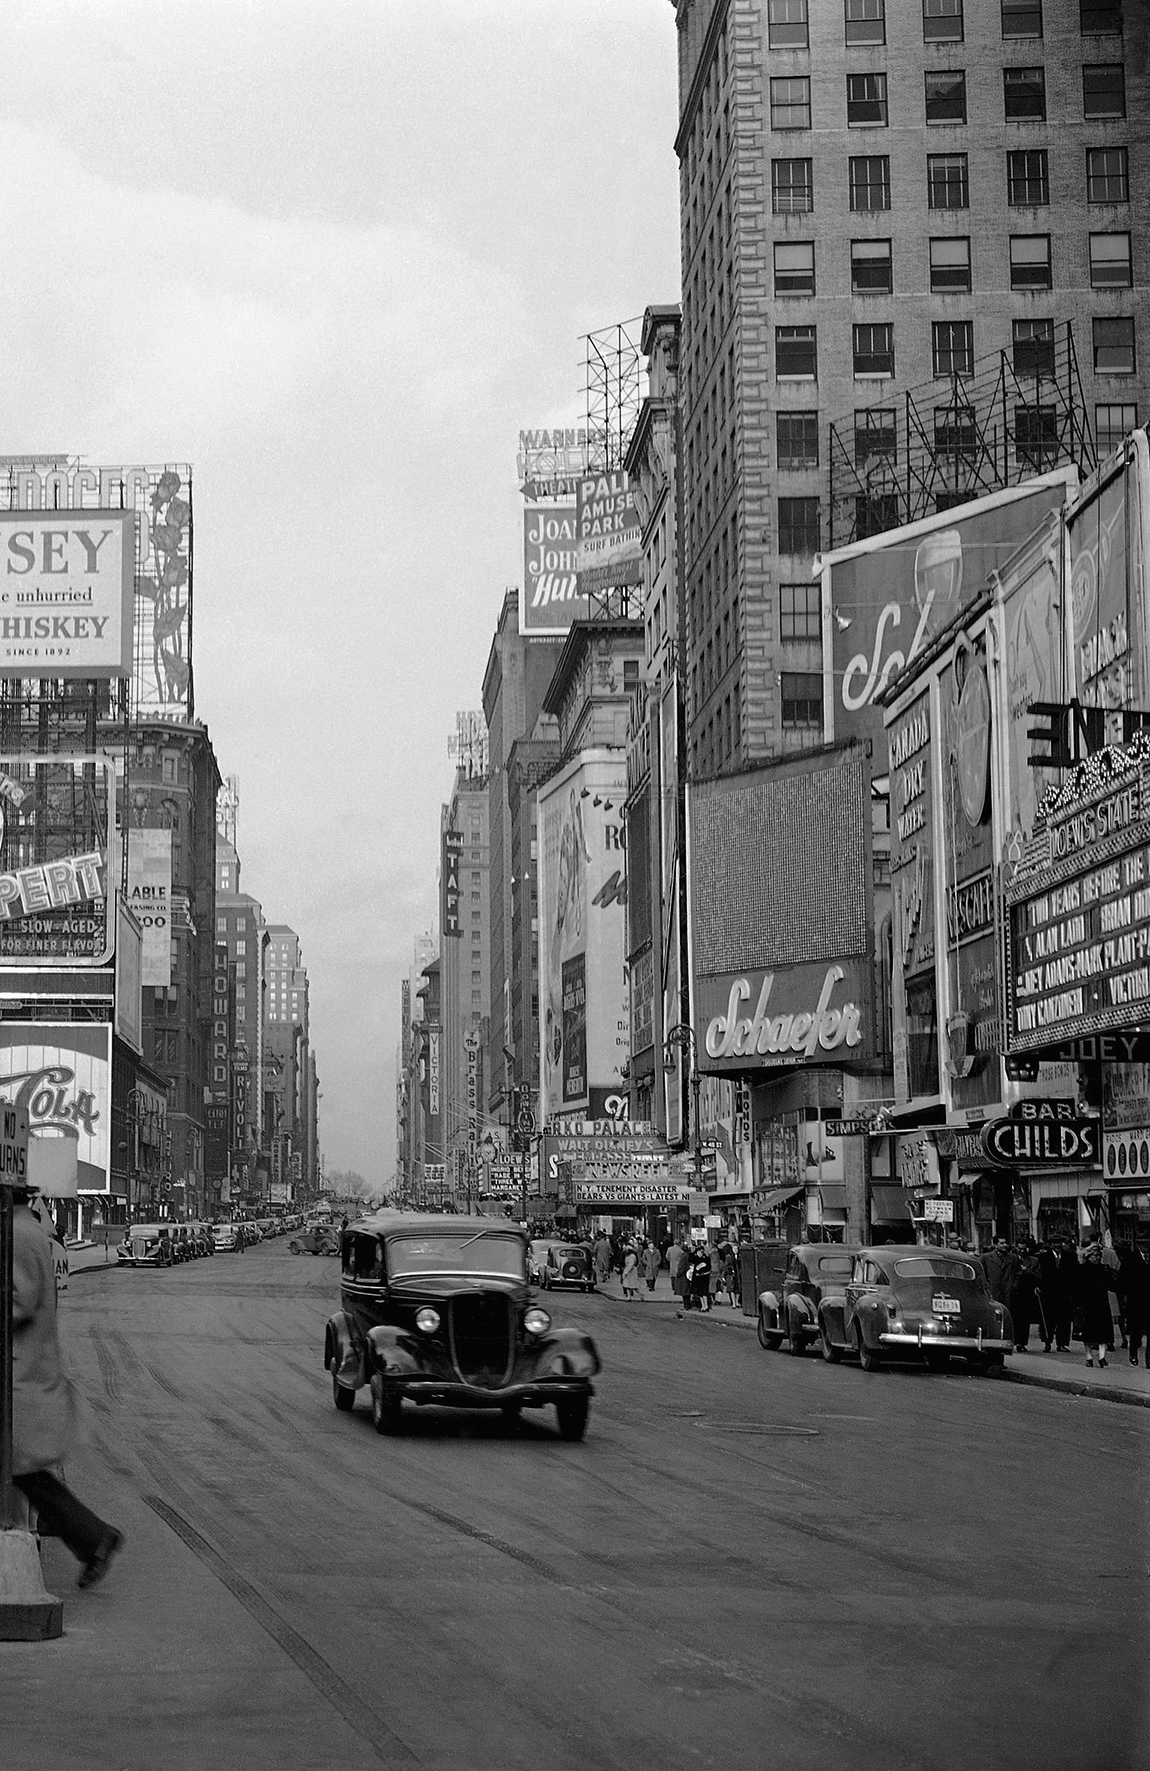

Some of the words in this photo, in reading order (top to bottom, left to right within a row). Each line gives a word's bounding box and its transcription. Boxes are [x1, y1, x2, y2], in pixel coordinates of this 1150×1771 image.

[582, 513, 625, 537] PARK
[584, 541, 605, 552] SURF
[610, 529, 642, 546] BATHIN
[16, 586, 93, 602] unhurried
[45, 648, 71, 656] 1892
[890, 710, 930, 770] CANADA
[903, 759, 926, 805] DRY
[1097, 782, 1139, 836] STATE
[1125, 851, 1144, 886] THE
[447, 852, 459, 930] TAFT
[2, 940, 23, 950] FOR
[25, 939, 58, 950] FINER
[214, 954, 228, 1083] HOWARD
[705, 965, 863, 1057] Schaefer
[1060, 1037, 1138, 1060] JOEY
[430, 1035, 439, 1113] VICTORIA
[468, 1051, 476, 1110] Brass
[5, 1110, 16, 1140] NO
[235, 1075, 245, 1149] RIVOLI
[1022, 1103, 1076, 1120] BAR
[553, 1121, 583, 1136] RKO
[594, 1121, 650, 1136] PALACE
[995, 1125, 1093, 1158] CHILDS
[558, 1140, 590, 1151] WALT
